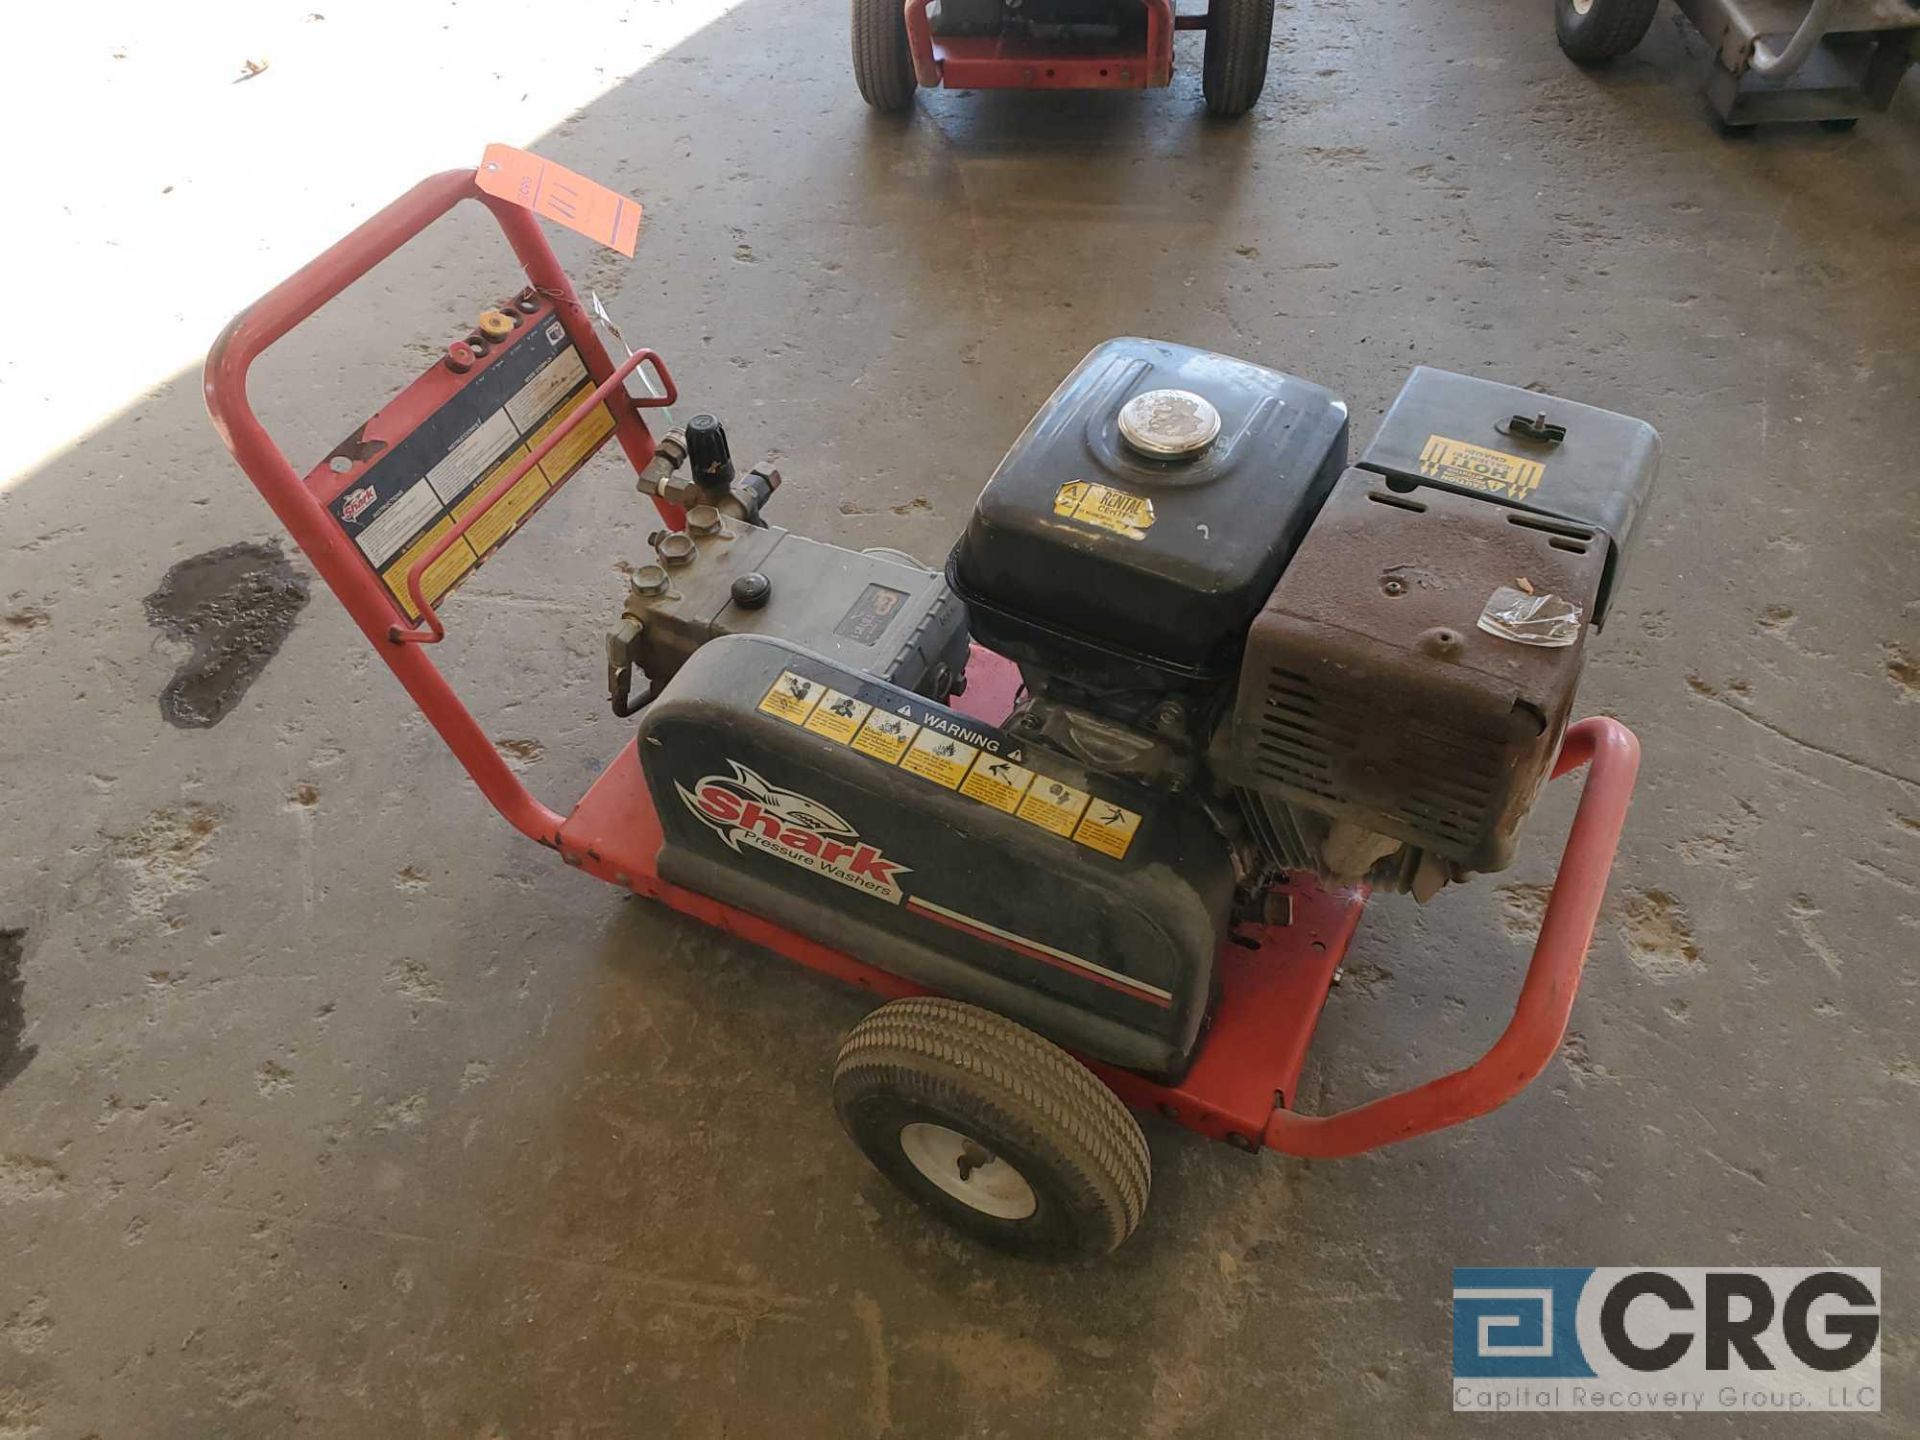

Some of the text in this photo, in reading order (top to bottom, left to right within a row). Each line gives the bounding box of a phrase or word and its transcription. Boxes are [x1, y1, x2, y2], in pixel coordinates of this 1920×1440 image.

[1440, 474, 1487, 490] CAUTION
[343, 489, 374, 519] Shark
[1100, 491, 1142, 515] RENTAL
[924, 712, 1000, 752] WARNING
[697, 784, 902, 886] Shark
[743, 830, 893, 896] Pressure Washers
